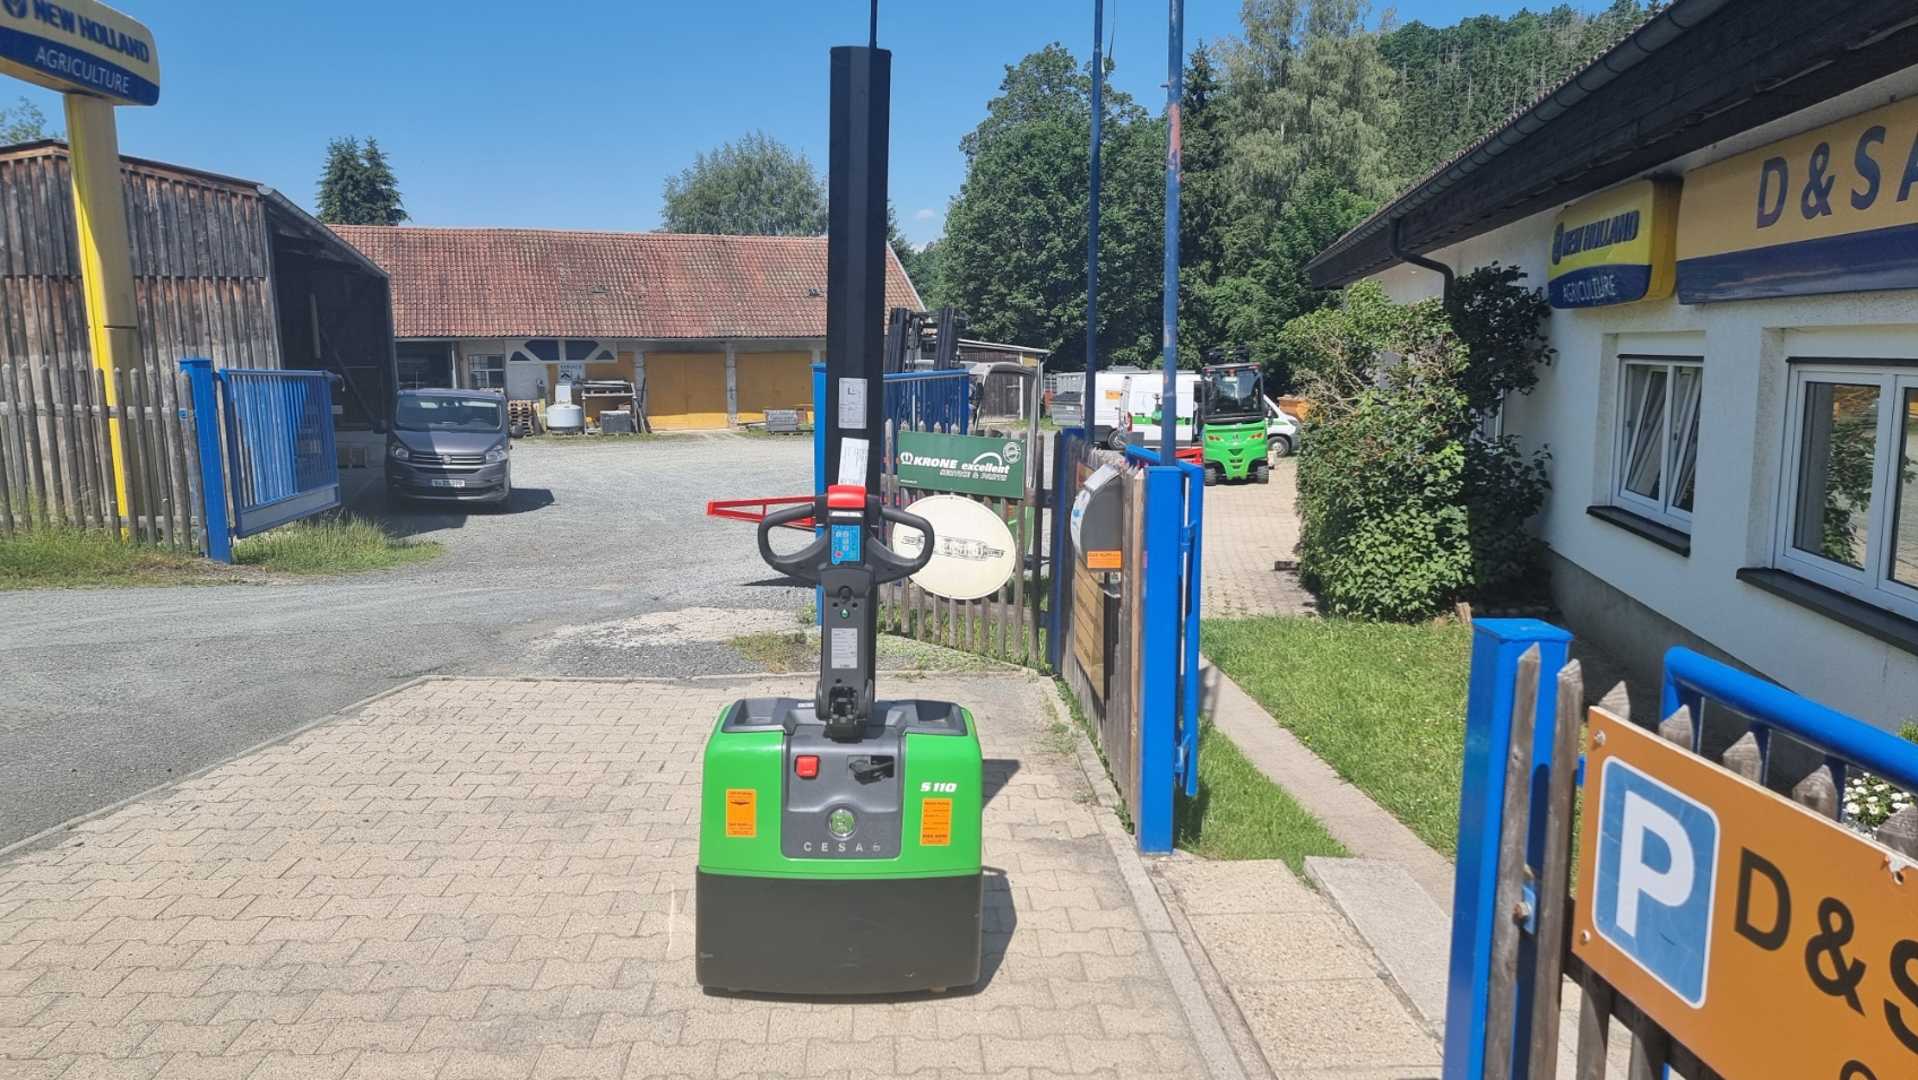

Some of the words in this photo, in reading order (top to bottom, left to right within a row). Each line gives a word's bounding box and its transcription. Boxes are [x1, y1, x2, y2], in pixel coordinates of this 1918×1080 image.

[33, 0, 75, 33] NEW
[78, 15, 149, 62] HOLLAND
[35, 46, 129, 94] AGRICULTURE
[1563, 226, 1584, 257] NEW
[1583, 210, 1640, 251] HOLLAND
[1563, 275, 1617, 302] AGRICULTURE
[914, 456, 957, 469] KRONE
[961, 462, 1010, 474] excellent
[920, 782, 932, 792] S
[933, 782, 957, 792] 110
[1616, 790, 1694, 938] P
